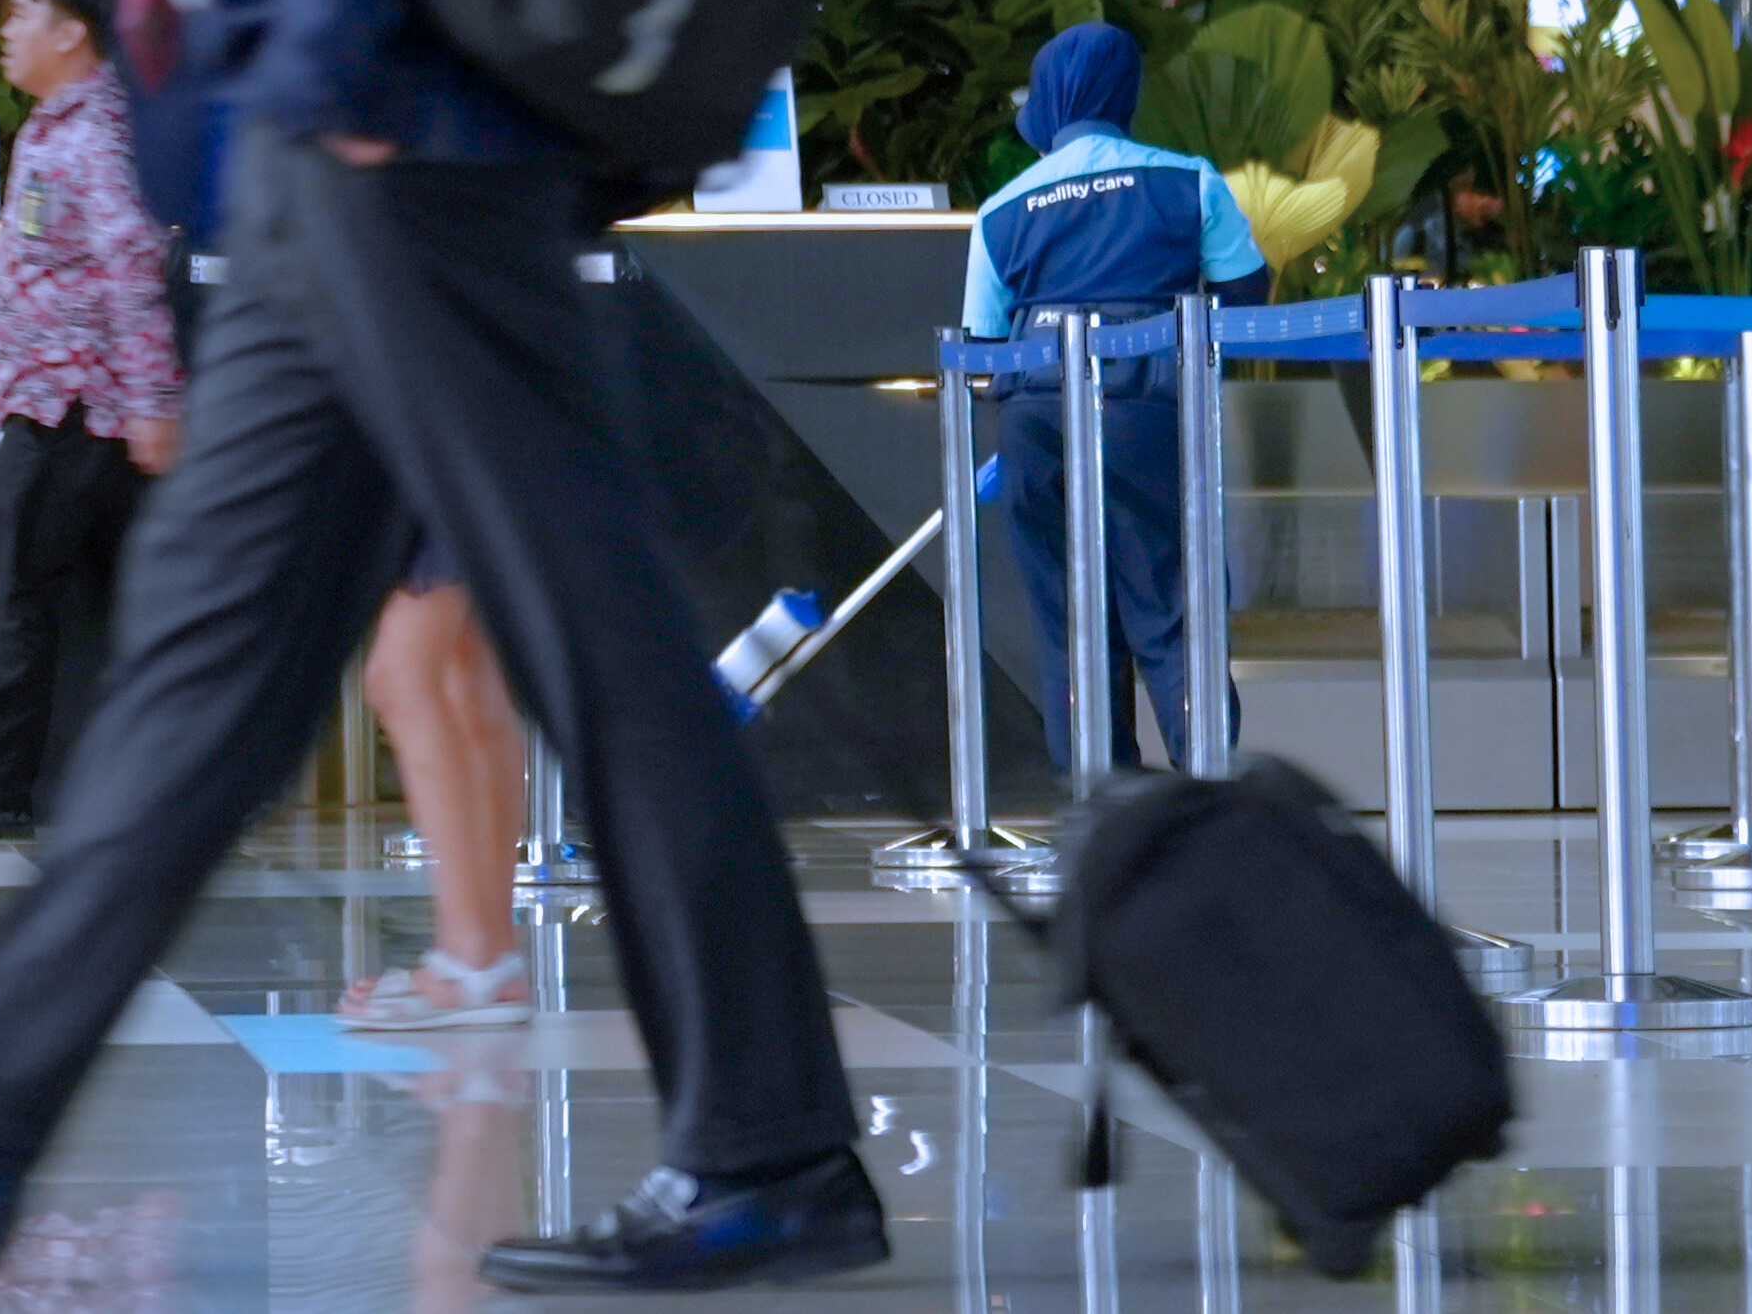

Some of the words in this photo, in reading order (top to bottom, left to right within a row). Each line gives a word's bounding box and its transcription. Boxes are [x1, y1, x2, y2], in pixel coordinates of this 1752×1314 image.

[841, 191, 919, 207] CLOSED
[1027, 180, 1089, 212] Facility
[1092, 174, 1135, 194] Care
